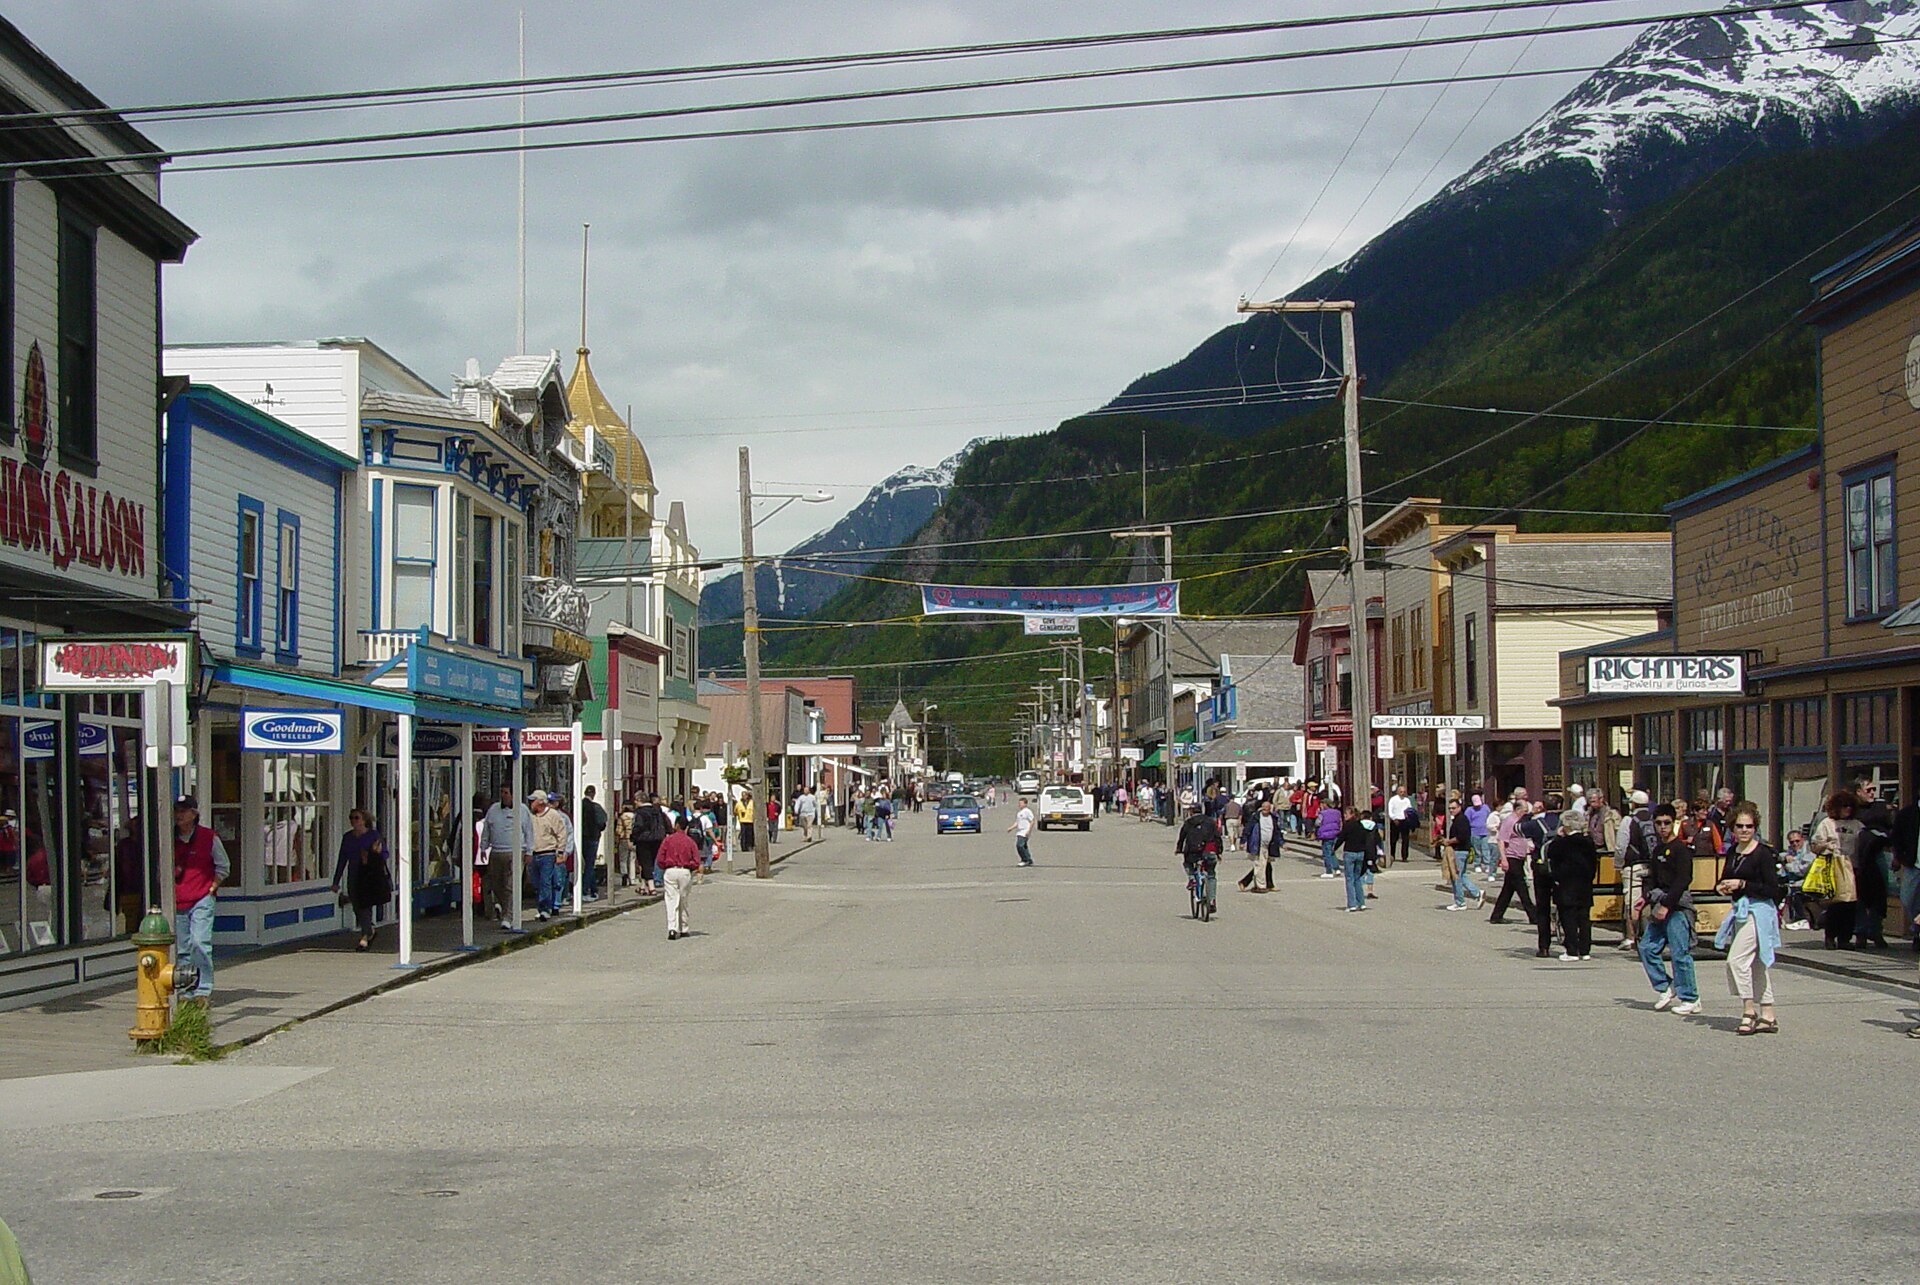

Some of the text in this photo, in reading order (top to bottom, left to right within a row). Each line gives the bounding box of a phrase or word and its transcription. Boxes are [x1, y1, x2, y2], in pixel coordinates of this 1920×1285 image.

[53, 470, 145, 579] SALOON
[1751, 585, 1793, 623] CURIOS
[104, 643, 169, 671] ONION
[1623, 680, 1662, 690] Jewelry
[1676, 680, 1706, 690] Curios
[262, 721, 325, 734] Goodmark
[1396, 717, 1456, 727] JEWELRY
[527, 732, 570, 743] Boutique
